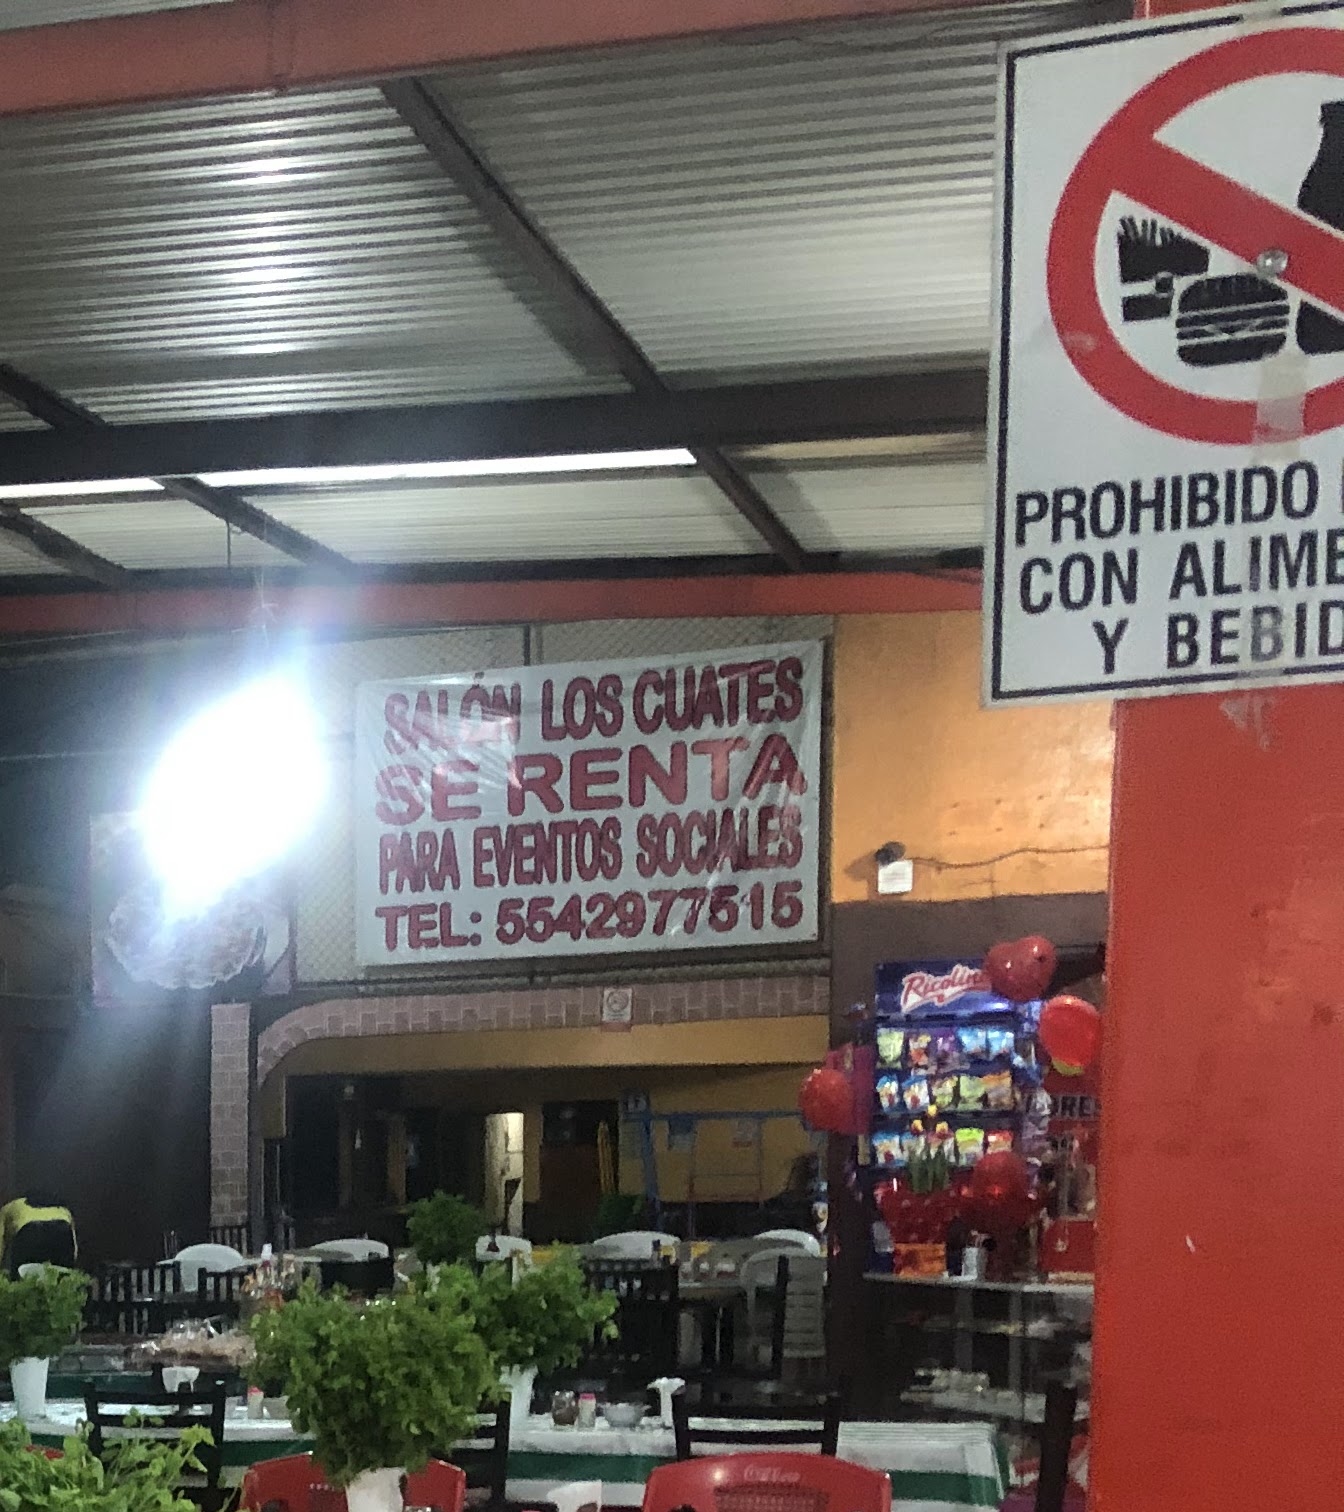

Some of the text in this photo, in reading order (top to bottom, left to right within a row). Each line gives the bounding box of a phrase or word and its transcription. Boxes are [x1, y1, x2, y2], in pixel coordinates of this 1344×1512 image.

[1015, 460, 1319, 546] PROHIBIDO
[1019, 528, 1344, 615] CON ALIME
[1092, 600, 1344, 675] Y BEBID
[541, 670, 624, 741] LOS
[633, 657, 804, 734] CUATES
[375, 733, 808, 826] SE RENTA
[379, 804, 804, 895] PARA EVENTOS SOCIALES
[375, 880, 804, 951] TEL: 5542977515
[901, 964, 991, 1008] Ricolin
